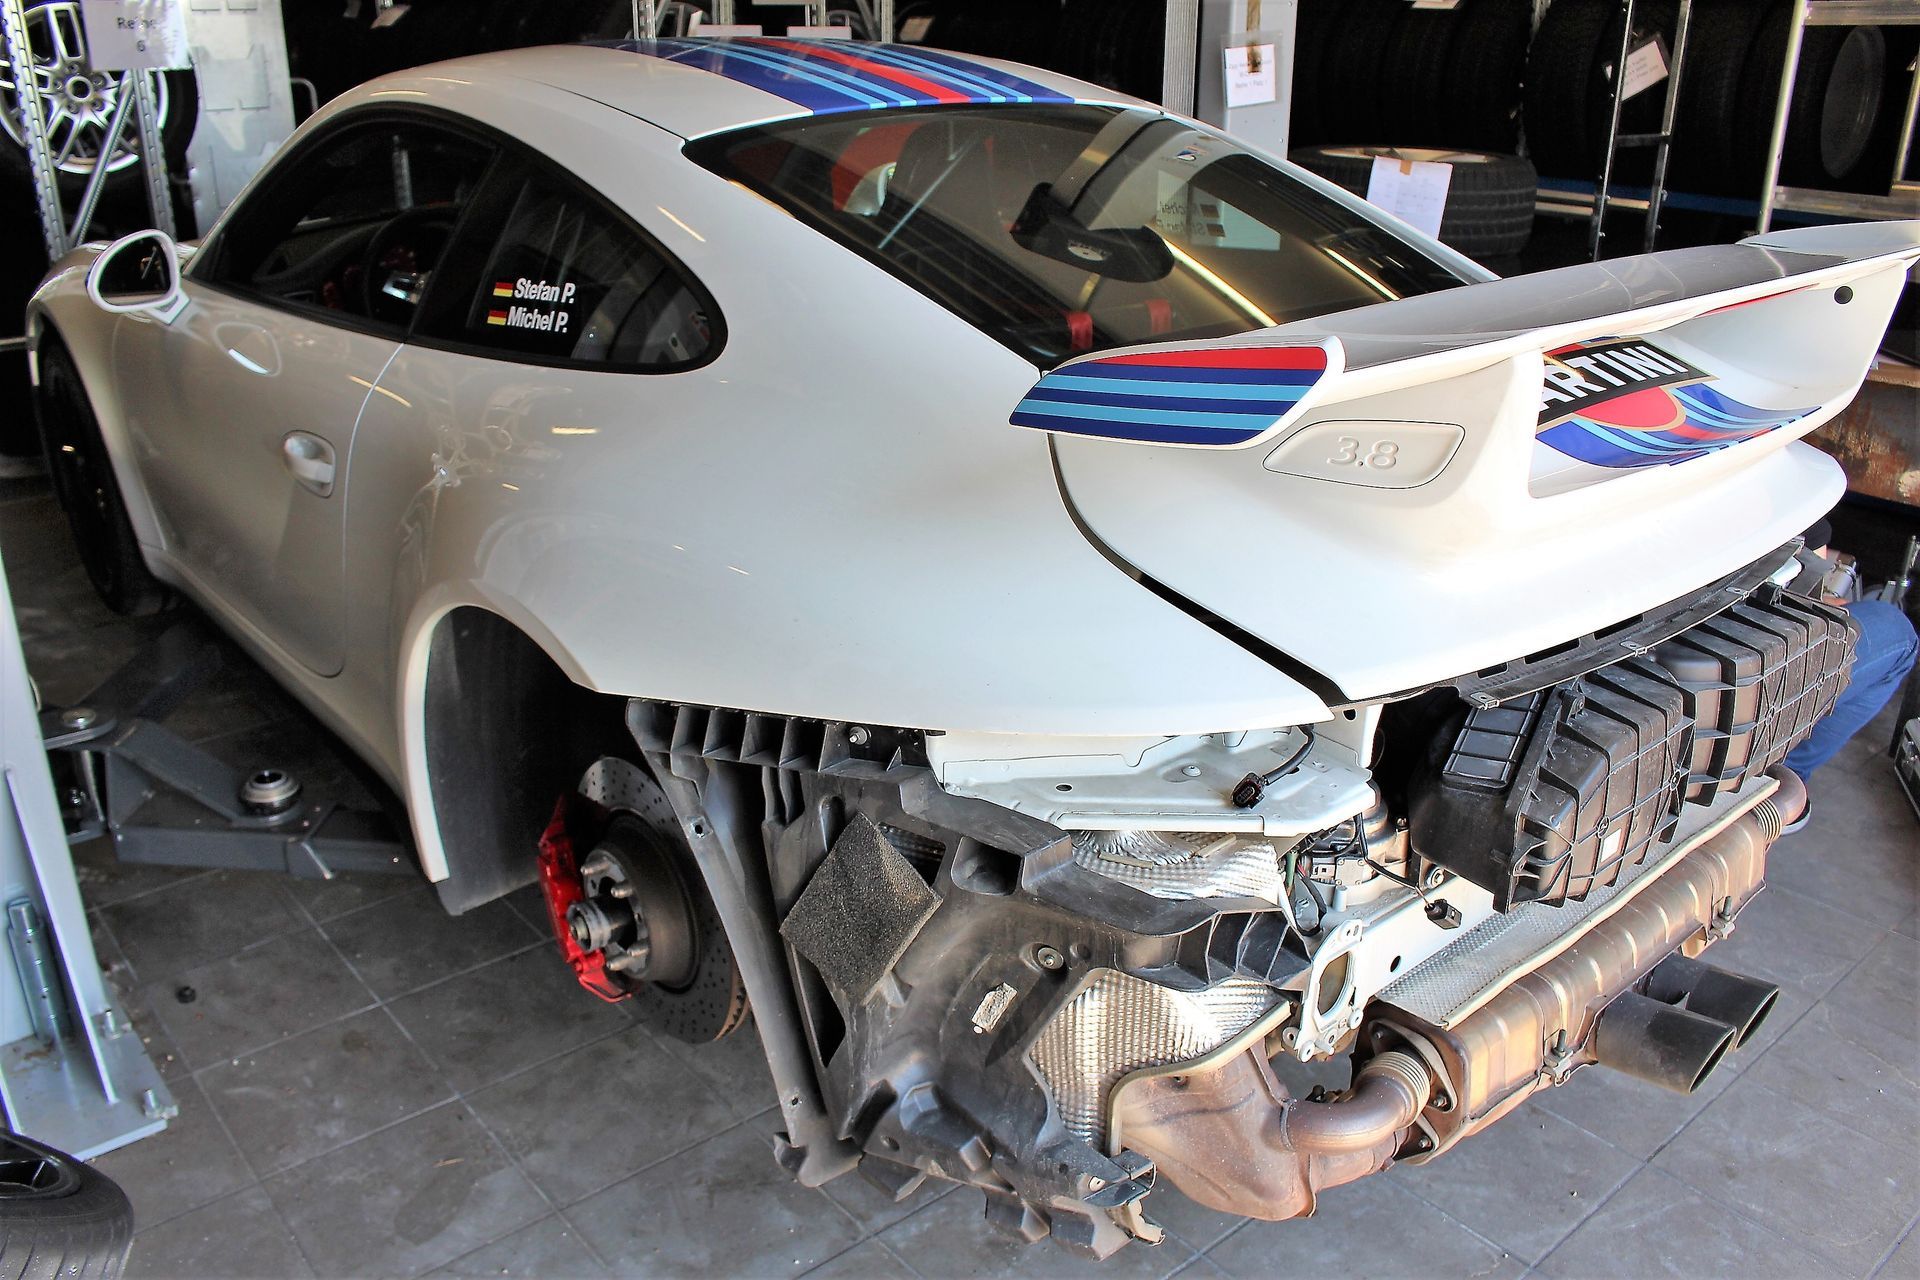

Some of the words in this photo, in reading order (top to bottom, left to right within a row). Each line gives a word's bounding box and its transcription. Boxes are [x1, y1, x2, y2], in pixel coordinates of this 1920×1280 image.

[514, 277, 560, 302] Stefan
[561, 282, 576, 304] P.
[507, 306, 554, 331] Michel
[555, 311, 569, 333] P.
[1540, 346, 1689, 409] ARTINI
[1327, 436, 1399, 470] 3.8
